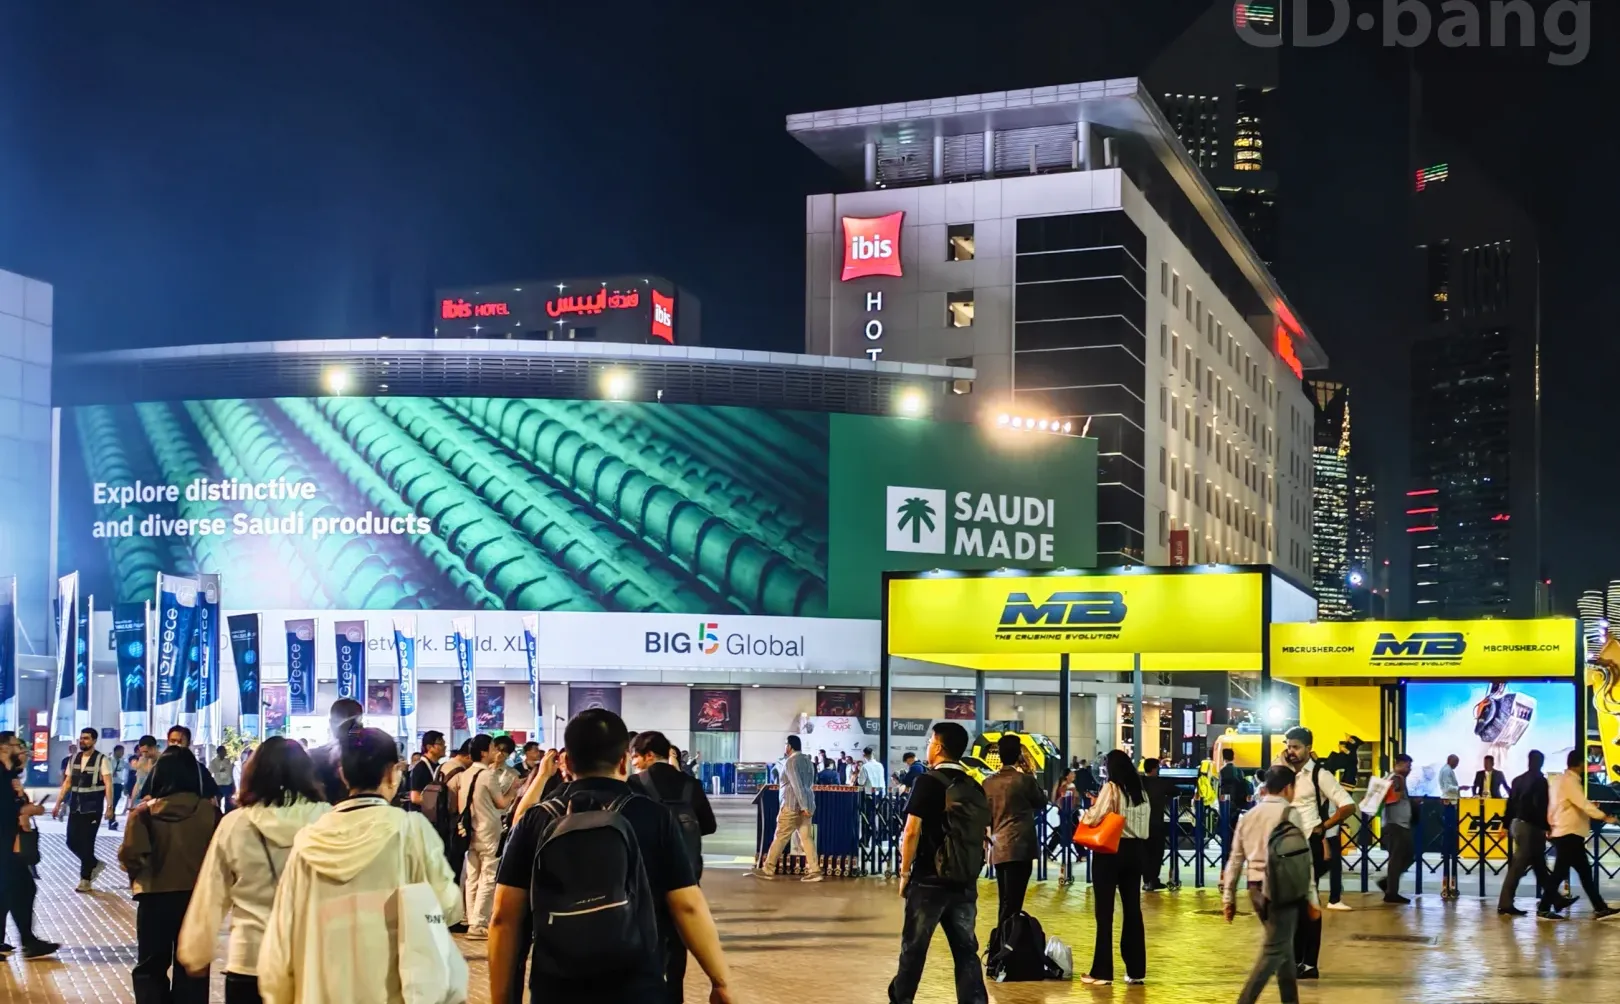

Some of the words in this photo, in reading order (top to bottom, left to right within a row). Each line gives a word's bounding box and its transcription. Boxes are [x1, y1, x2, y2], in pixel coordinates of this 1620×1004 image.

[852, 234, 892, 260] ibis
[442, 299, 472, 319] ibis
[475, 302, 510, 317] HOTEL
[655, 303, 671, 327] ibis
[93, 482, 180, 508] Explore
[185, 477, 316, 502] distinctive
[954, 491, 1055, 528] SAUDI
[92, 514, 134, 538] and
[140, 514, 226, 537] diverse
[232, 510, 304, 536] Saudi
[311, 510, 432, 539] products
[953, 527, 1054, 562] MADE
[999, 591, 1128, 625] MB
[645, 631, 691, 653] BIG
[698, 622, 720, 655] 5
[726, 633, 804, 656] Global
[1065, 632, 1120, 640] EVOLUTION
[1372, 632, 1467, 656] MB
[1483, 644, 1560, 652] MBCRUSHER.COM
[290, 643, 301, 695] Greece
[340, 645, 352, 697] Greece
[892, 720, 924, 731] Pavilion
